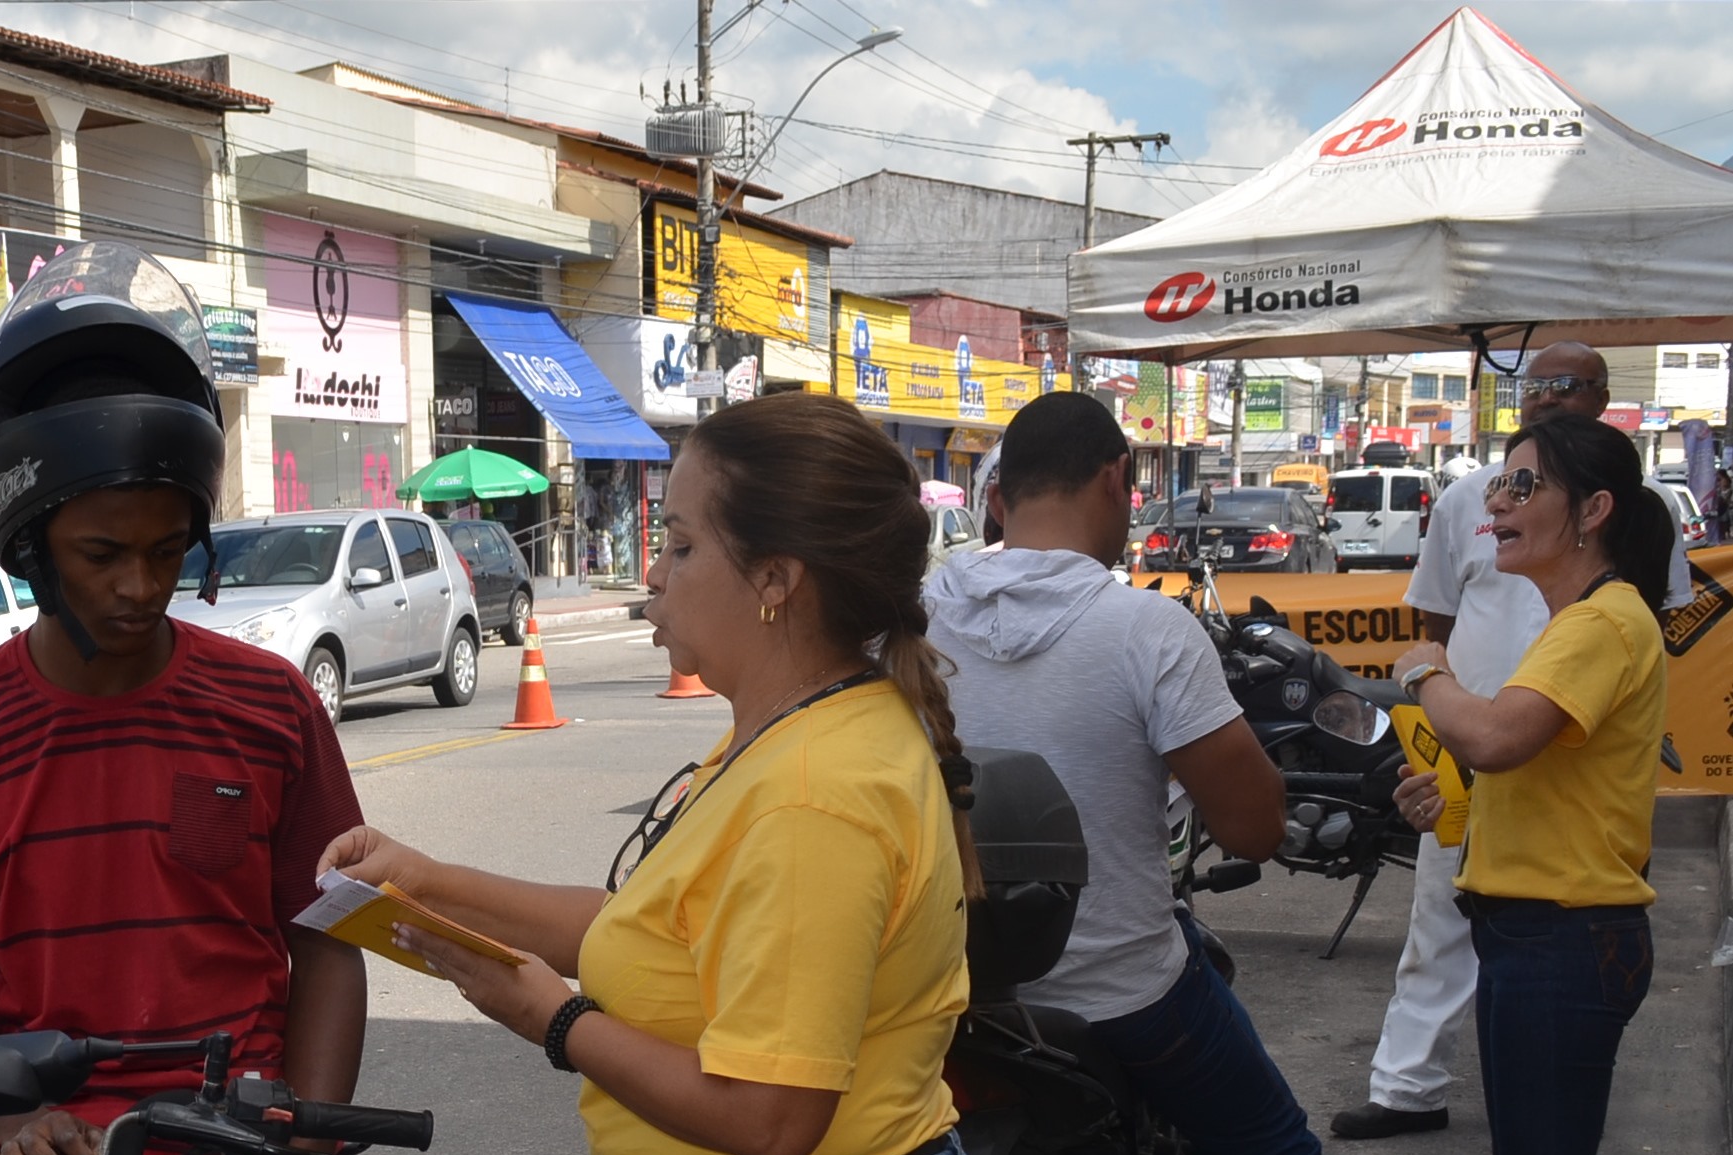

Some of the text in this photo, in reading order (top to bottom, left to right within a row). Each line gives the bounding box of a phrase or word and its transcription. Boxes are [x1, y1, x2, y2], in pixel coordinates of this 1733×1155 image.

[1417, 105, 1585, 123] Consórcio Nacional
[1413, 118, 1584, 145] Honda
[1384, 151, 1471, 168] garantida
[1521, 146, 1587, 158] fábrica
[1223, 258, 1361, 284] Consórcio Nacional
[1224, 279, 1361, 316] Honda
[502, 351, 582, 398] TACO
[435, 398, 473, 416] TACO
[1275, 468, 1314, 478] CHAVEIRO
[1663, 591, 1721, 643] COLETIVA
[1706, 767, 1722, 778] DO
